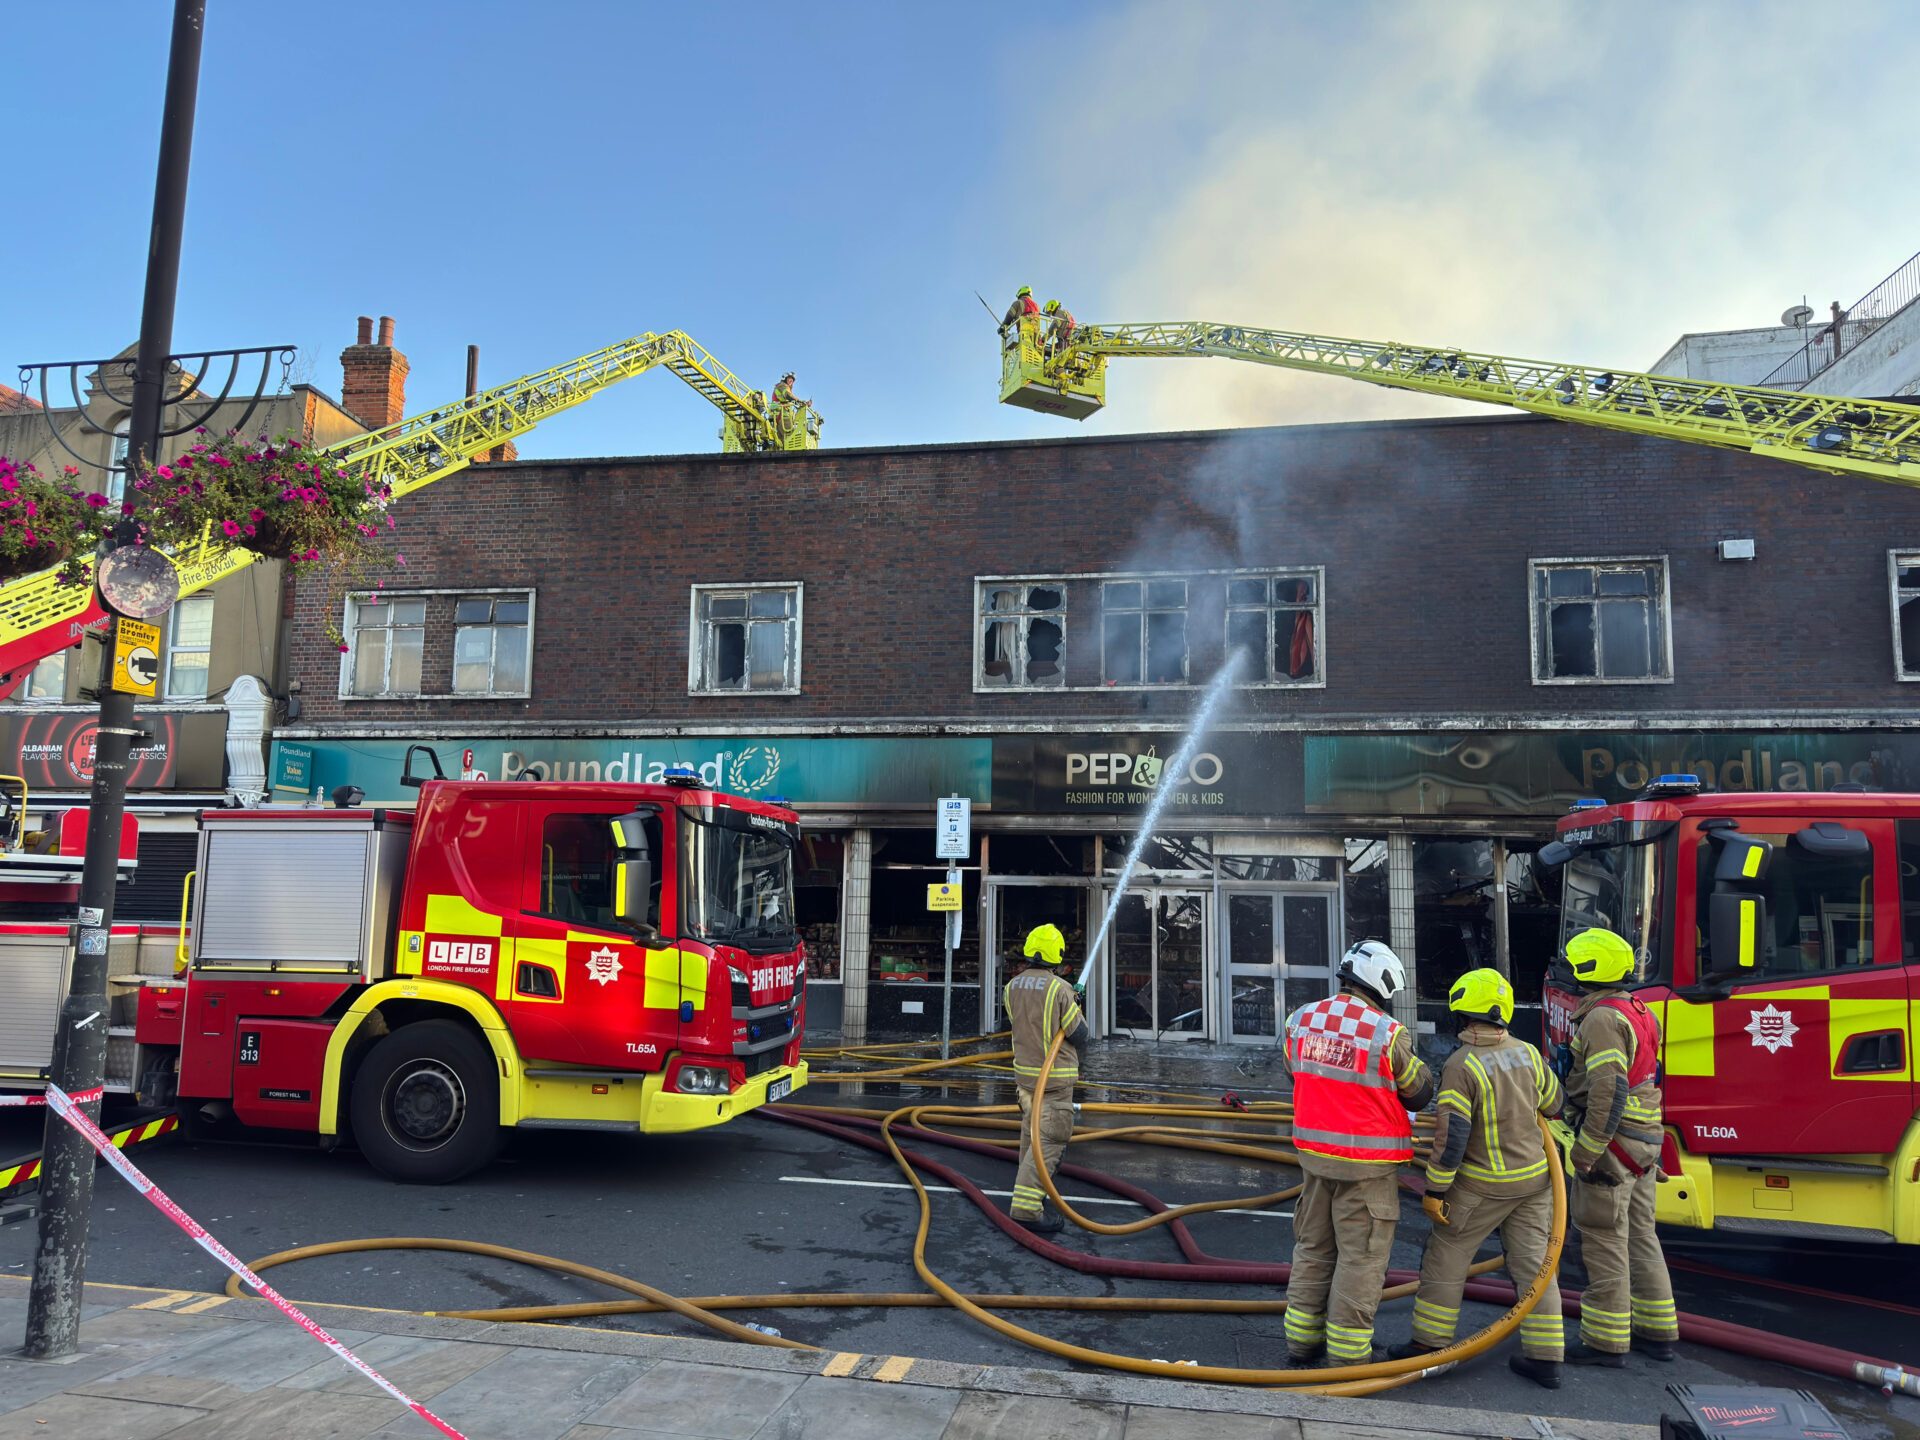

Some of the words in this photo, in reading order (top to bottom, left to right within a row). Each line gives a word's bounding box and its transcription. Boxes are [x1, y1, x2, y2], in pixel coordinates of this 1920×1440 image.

[89, 614, 111, 628] MAGIR
[120, 620, 144, 630] Safer
[120, 628, 155, 642] Bromley
[22, 744, 63, 752] ALBANIAN
[280, 745, 311, 758] Poundland
[20, 752, 62, 760] FLAVOURS
[128, 752, 168, 760] CLASSICS
[1065, 792, 1104, 805] FASHION
[1106, 792, 1125, 805] FOR
[1192, 793, 1199, 805] &
[1201, 792, 1224, 805] KIDS
[427, 964, 451, 972] LONDON
[776, 964, 794, 988] FIRE
[1011, 976, 1048, 990] FIRE
[247, 1035, 254, 1047] E
[626, 1042, 656, 1054] TL65A
[240, 1050, 258, 1061] 313
[1480, 1046, 1533, 1076] FIRE
[1694, 1124, 1738, 1140] TL60A
[1700, 1405, 1777, 1422] Milwaukee
